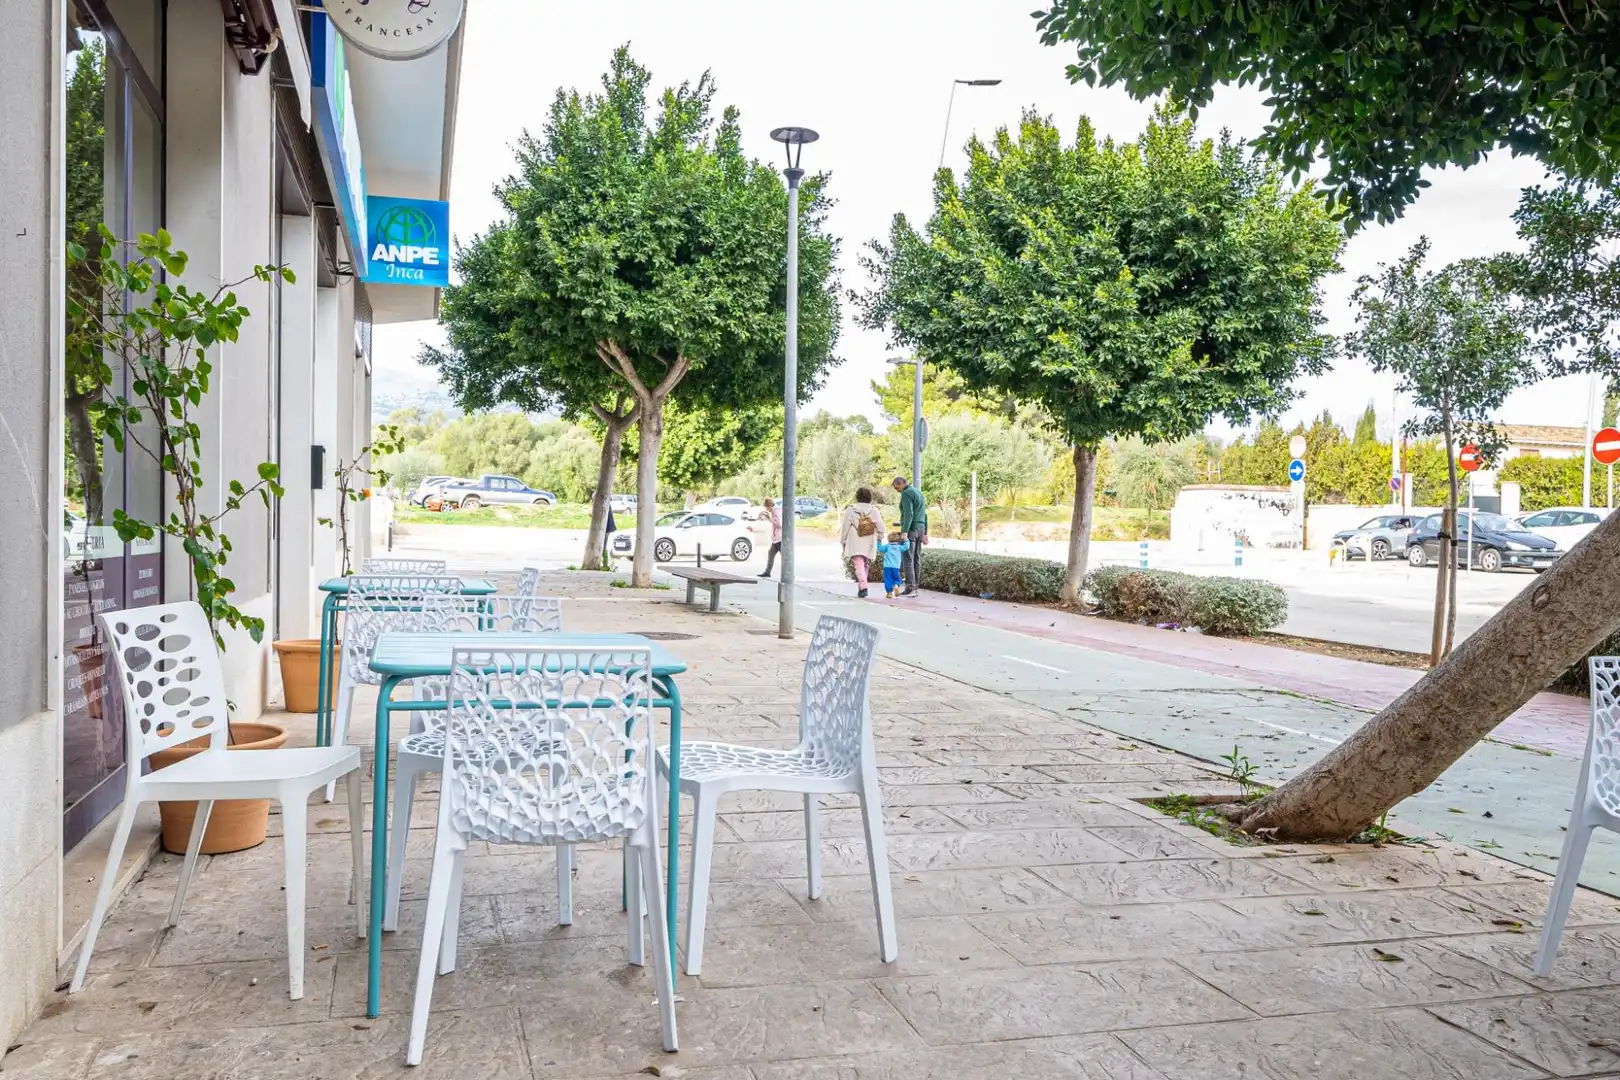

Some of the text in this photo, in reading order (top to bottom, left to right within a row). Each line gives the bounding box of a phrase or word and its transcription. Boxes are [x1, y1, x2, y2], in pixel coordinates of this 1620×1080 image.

[345, 8, 434, 37] FRANCESA
[371, 243, 439, 265] ANPE
[386, 263, 424, 279] Inca
